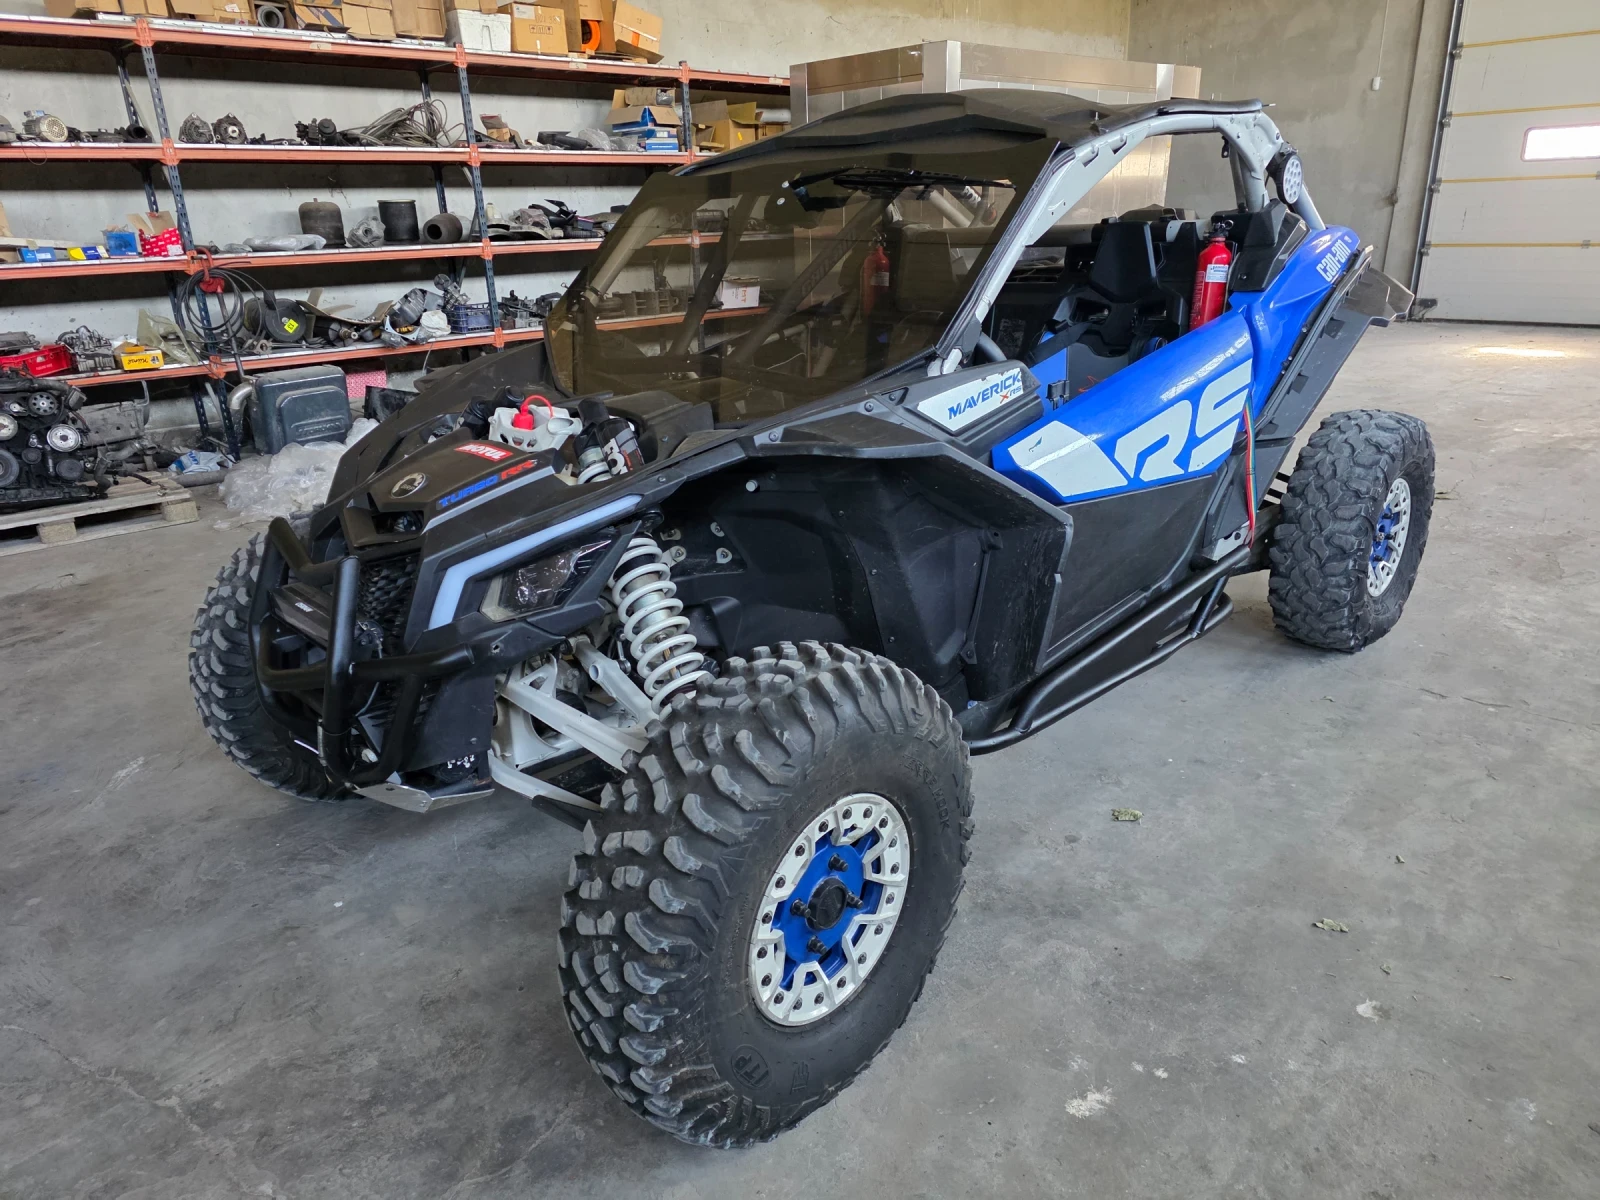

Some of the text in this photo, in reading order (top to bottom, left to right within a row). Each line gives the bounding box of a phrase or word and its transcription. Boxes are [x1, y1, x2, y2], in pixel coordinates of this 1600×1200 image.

[1315, 239, 1351, 282] can-am
[947, 371, 1021, 420] MAVERICK
[1113, 358, 1253, 482] RS
[458, 443, 507, 460] MOTUL
[438, 475, 499, 507] TURBO
[734, 1053, 770, 1086] ITP
